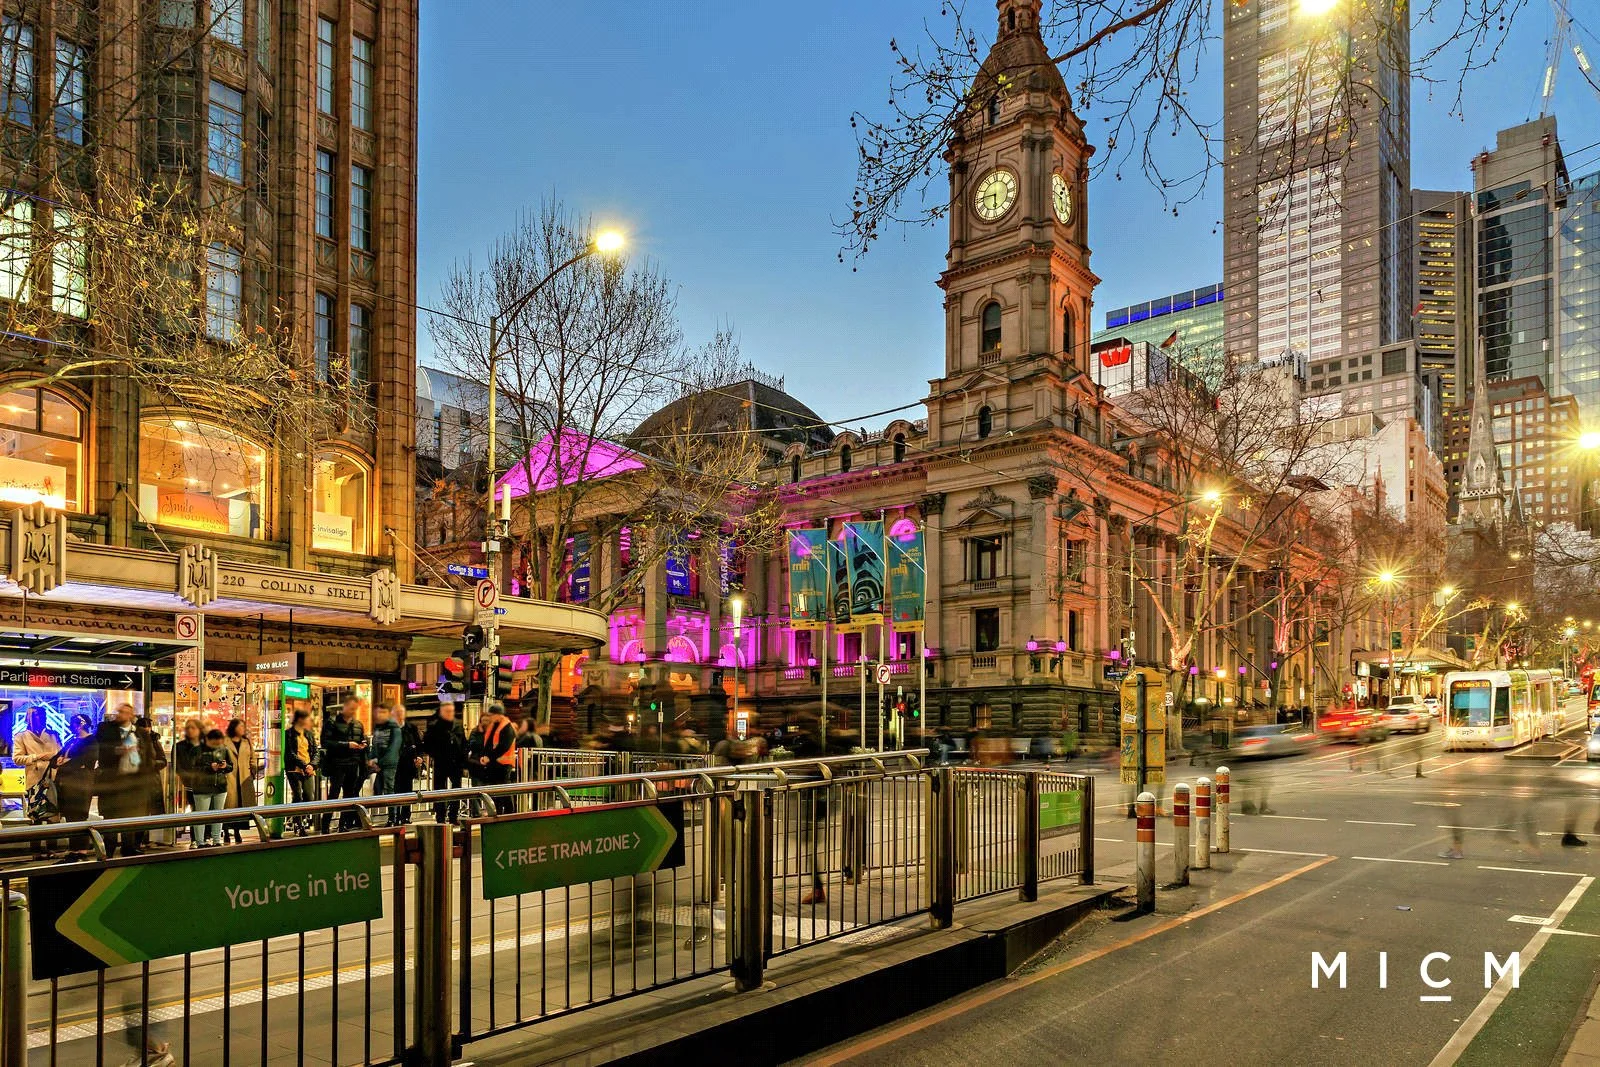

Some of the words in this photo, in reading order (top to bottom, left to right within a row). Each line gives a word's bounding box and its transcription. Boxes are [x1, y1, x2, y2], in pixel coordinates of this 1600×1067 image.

[161, 496, 194, 515] Smile
[317, 524, 348, 537] invisalign
[222, 575, 245, 587] 220
[260, 579, 315, 595] COLLINS
[327, 587, 366, 600] STREET
[0, 670, 67, 684] Parliament
[70, 674, 112, 686] Station
[508, 846, 547, 868] FREE
[551, 840, 592, 860] TRAM
[595, 834, 630, 855] ZONE
[224, 879, 301, 909] You're
[308, 874, 328, 897] in
[334, 869, 370, 893] the
